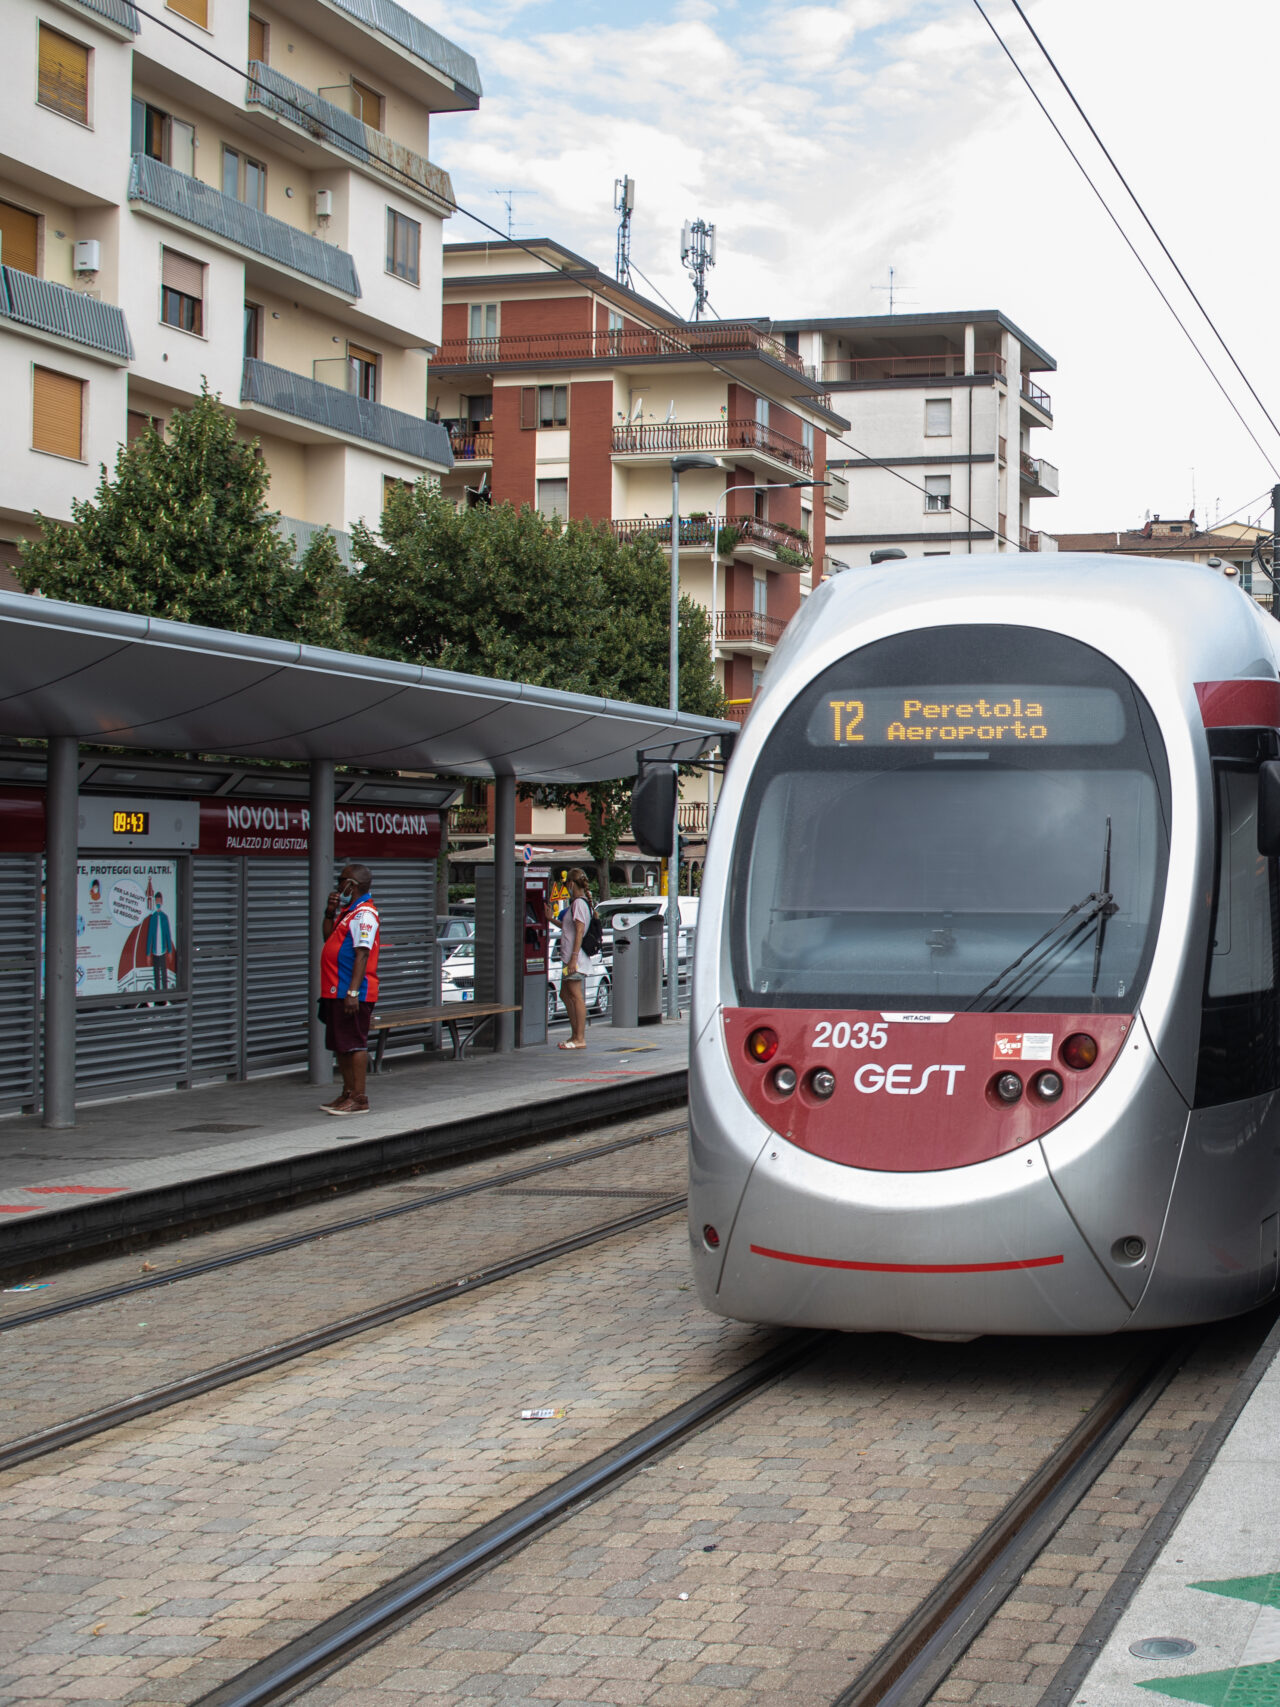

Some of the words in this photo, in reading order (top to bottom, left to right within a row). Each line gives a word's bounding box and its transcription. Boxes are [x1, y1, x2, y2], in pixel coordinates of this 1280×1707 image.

[903, 698, 1044, 718] Peretola
[829, 700, 865, 741] T2
[886, 720, 1049, 741] Aeroporto
[113, 811, 144, 833] 09:43
[226, 804, 289, 831] NOVOLI
[302, 808, 365, 834] RONE
[366, 811, 429, 836] TOSCANA
[226, 836, 261, 849] PALAZZO
[262, 837, 271, 849] DI
[272, 837, 308, 850] GIUSTIZIA
[90, 865, 131, 875] PROTEGGI
[132, 865, 146, 875] GLI
[147, 865, 172, 876] ALTRI.
[811, 1021, 889, 1050] 2035
[853, 1063, 966, 1096] GEST
